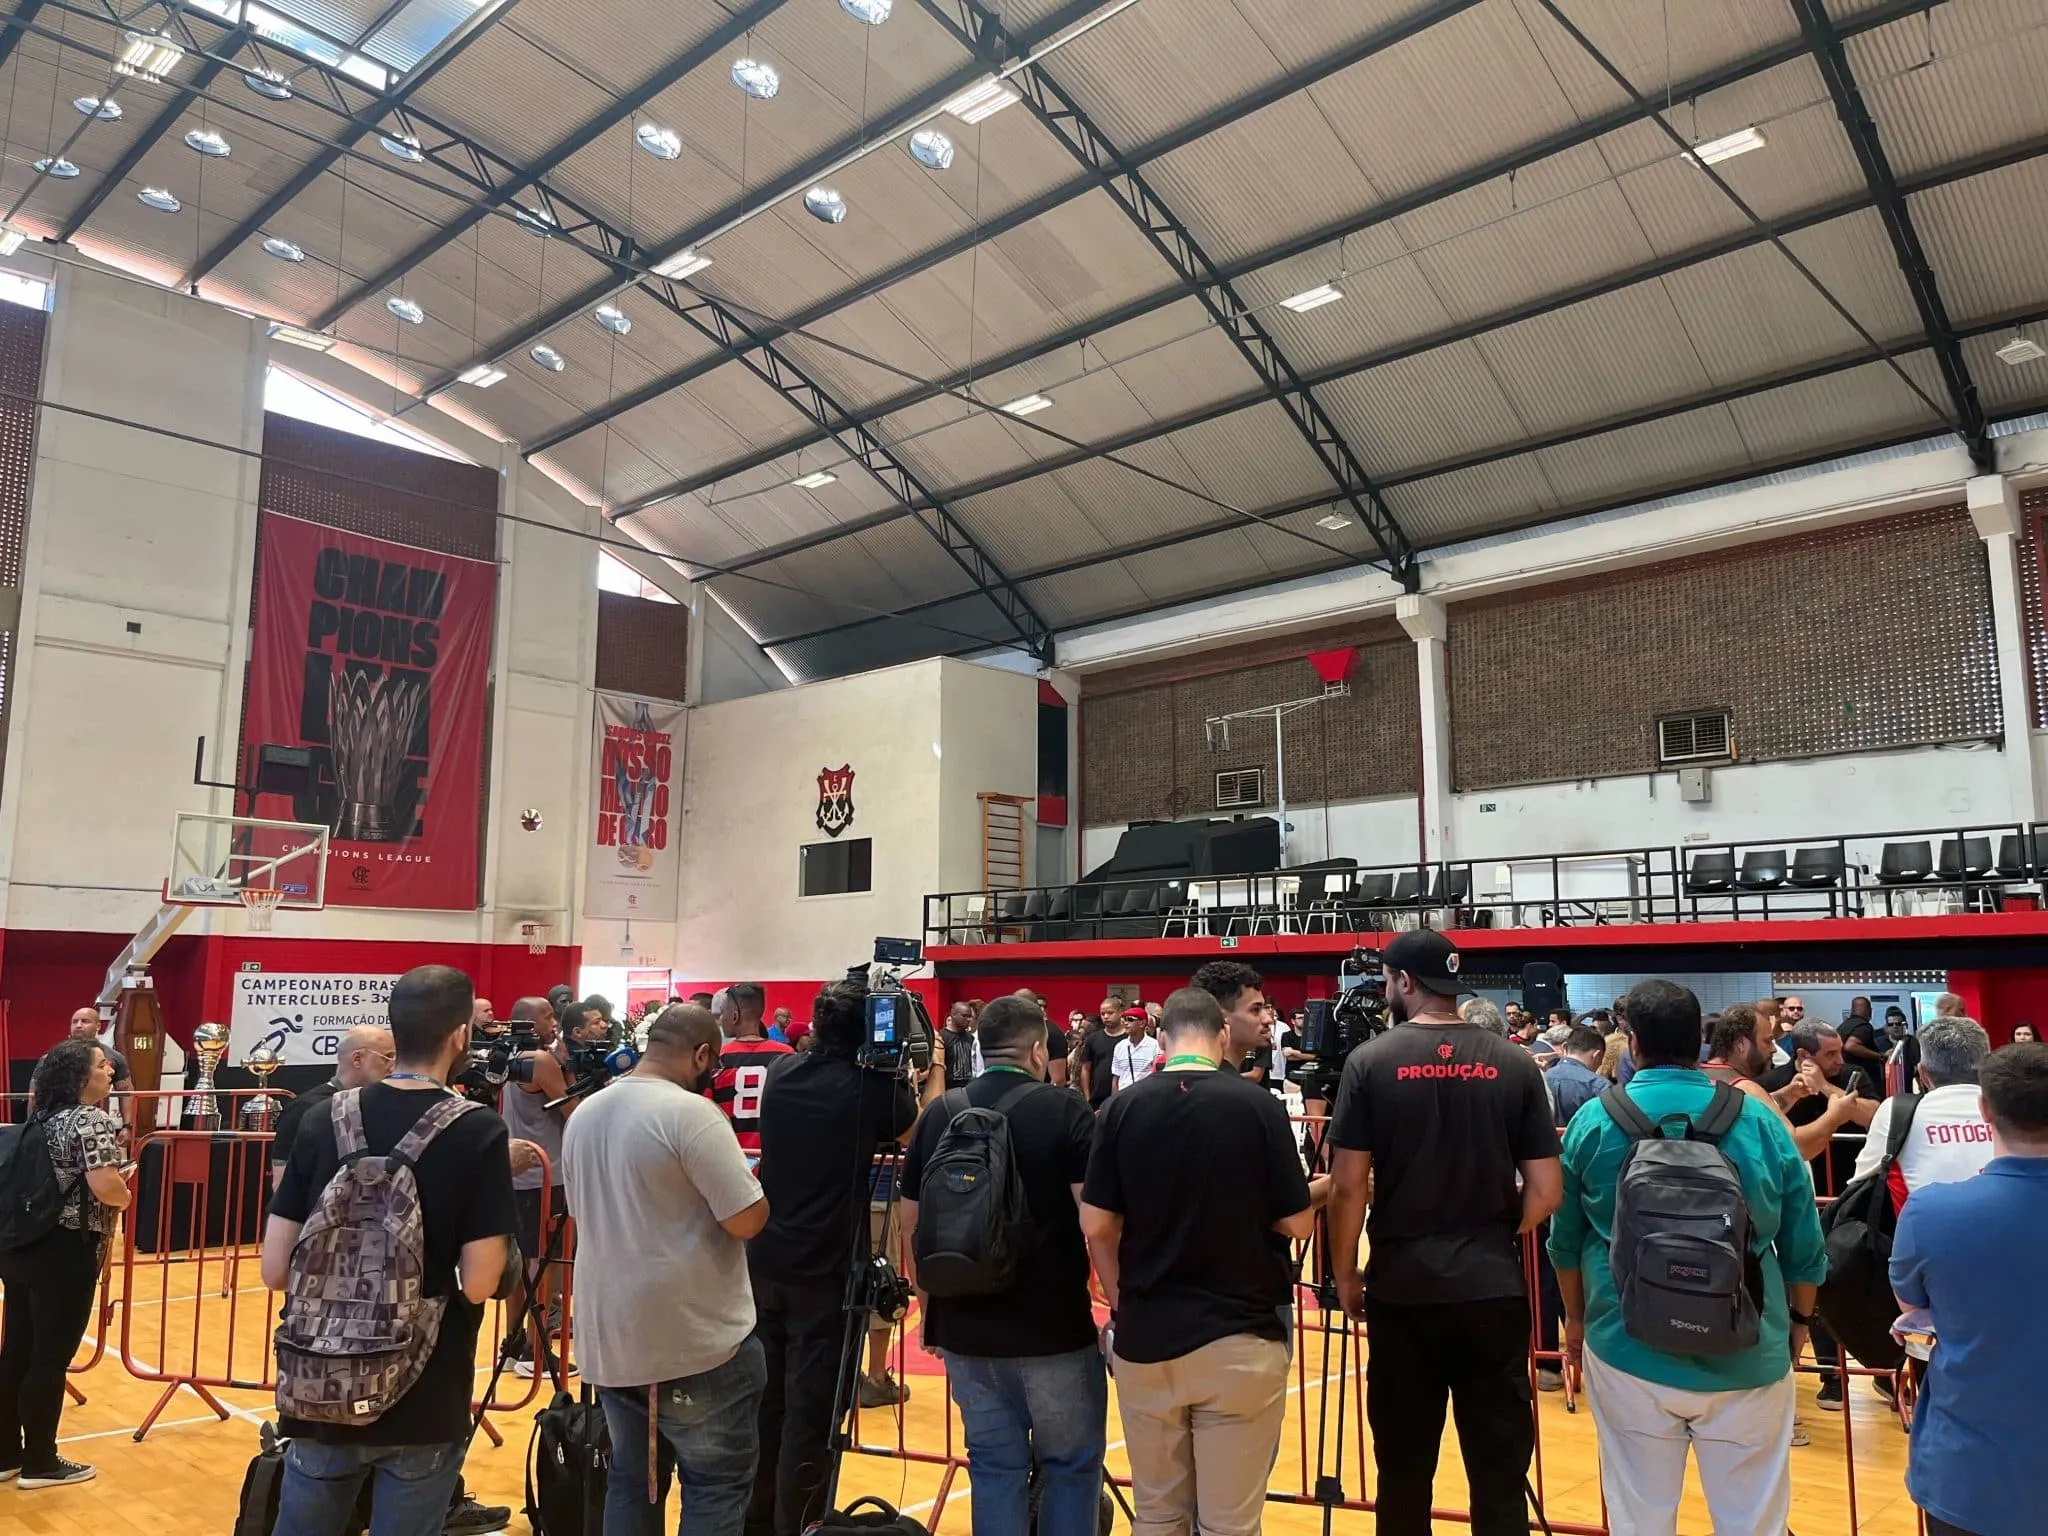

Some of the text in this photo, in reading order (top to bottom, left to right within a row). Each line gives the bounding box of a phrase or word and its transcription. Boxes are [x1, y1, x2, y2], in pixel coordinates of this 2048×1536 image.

[307, 600, 440, 669] PIONS
[597, 814, 616, 846] DE
[378, 852, 432, 863] LEAGUE
[241, 979, 353, 991] CAMPEONATO
[313, 1013, 391, 1026] FORMAÇÃO DE
[1397, 1063, 1498, 1081] PRODUÇÃO
[733, 1065, 767, 1119] 8
[1671, 1318, 1709, 1333] sportv
